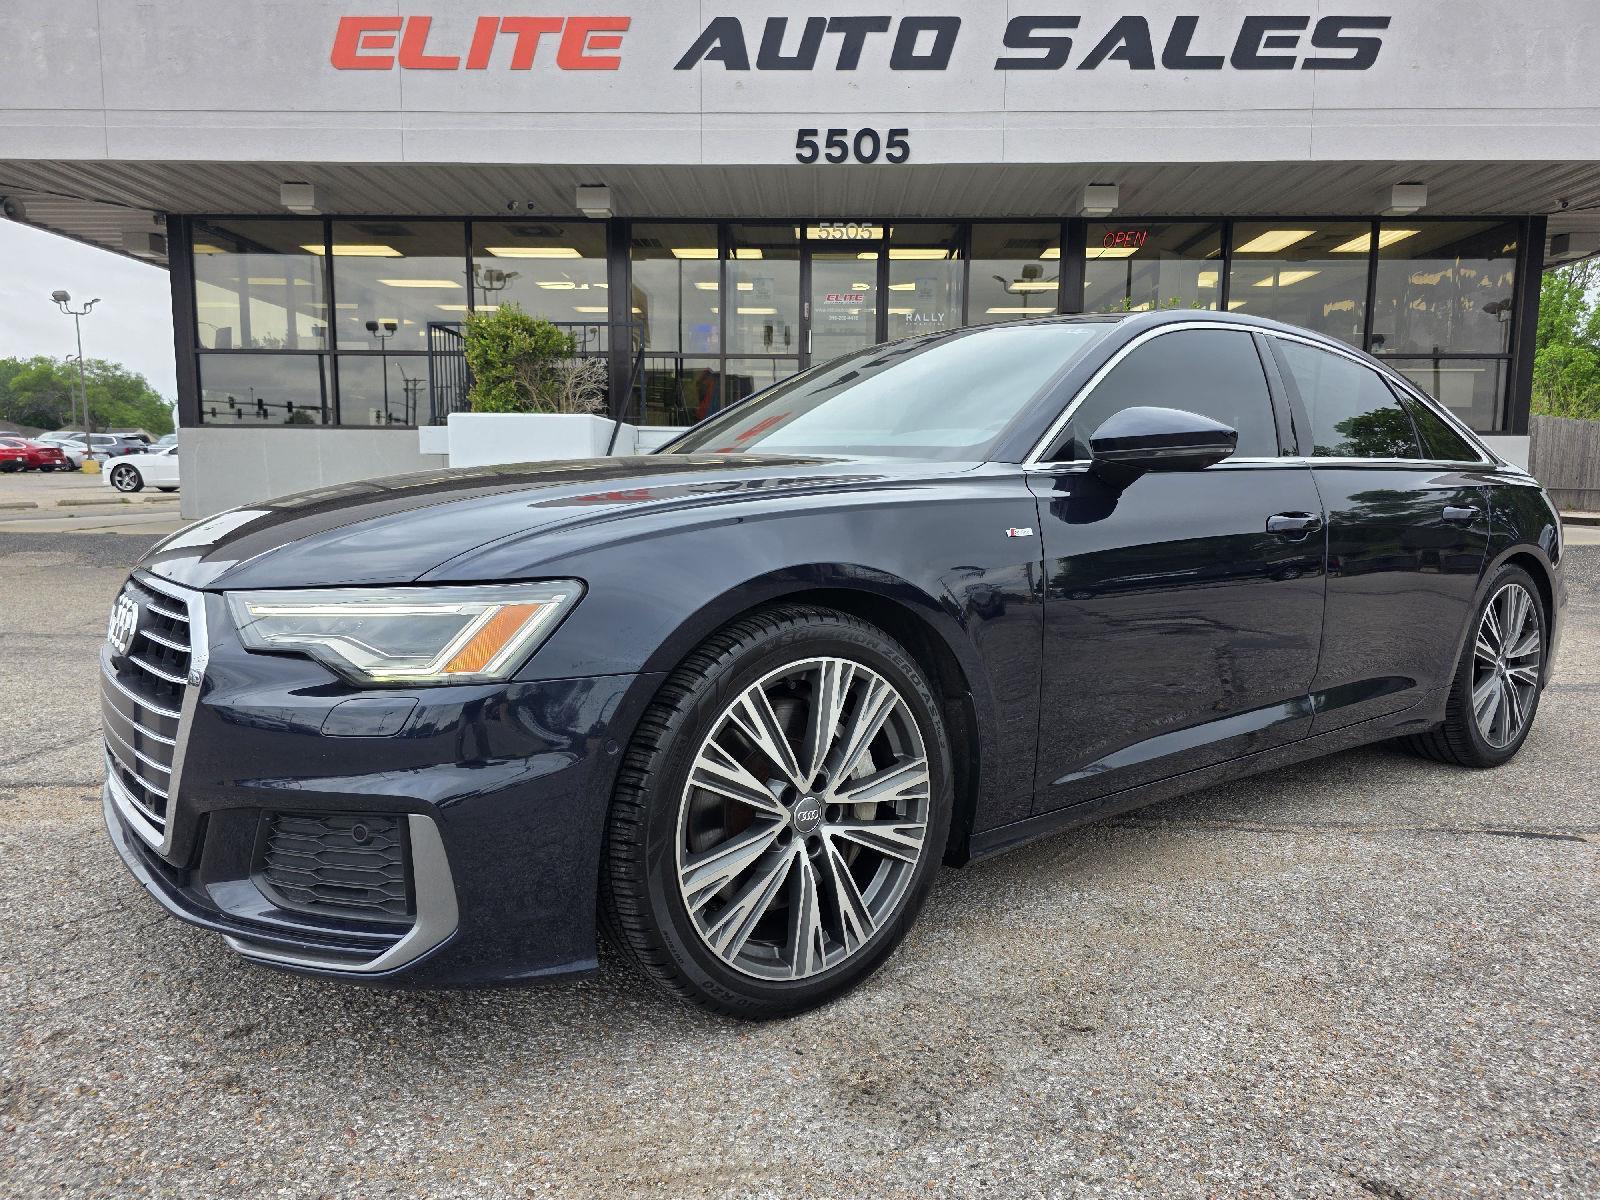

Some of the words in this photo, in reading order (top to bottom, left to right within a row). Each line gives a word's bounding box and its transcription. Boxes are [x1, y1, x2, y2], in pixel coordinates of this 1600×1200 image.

[331, 15, 631, 71] ELITE
[673, 15, 962, 71] AUTO
[993, 15, 1392, 71] SALES
[795, 128, 910, 164] 5505
[818, 222, 873, 240] 5505
[1103, 230, 1148, 248] OPEN
[826, 293, 863, 302] ELITE
[905, 313, 945, 322] RALLY
